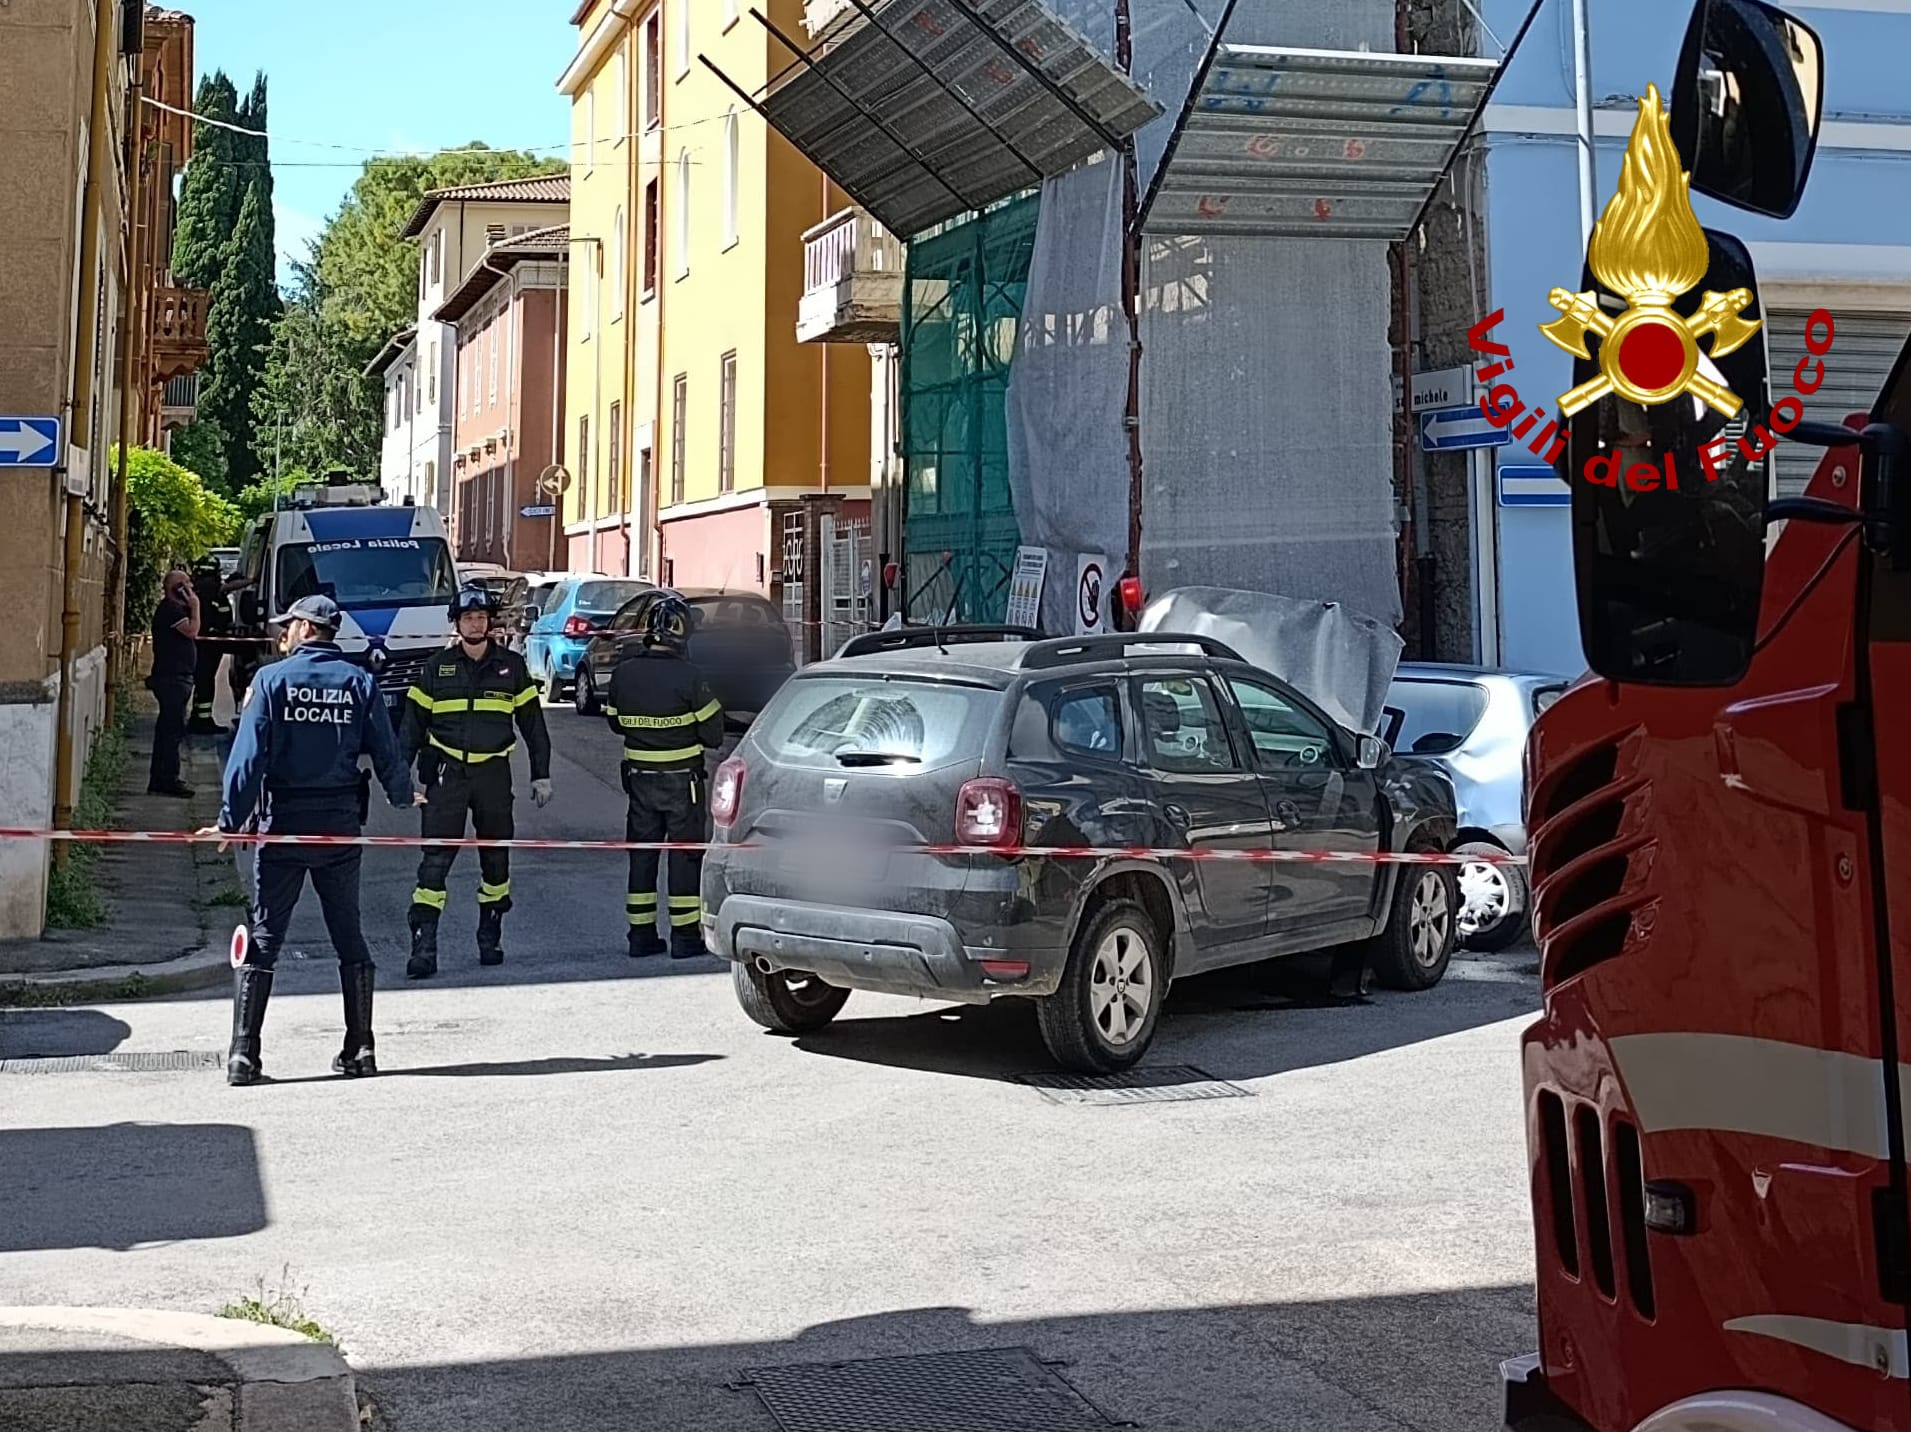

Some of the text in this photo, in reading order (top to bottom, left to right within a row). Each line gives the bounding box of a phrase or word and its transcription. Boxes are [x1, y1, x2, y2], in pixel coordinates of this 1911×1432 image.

[1414, 389, 1448, 405] michele
[287, 687, 354, 705] POLIZIA
[284, 706, 353, 724] LOCALE
[653, 717, 682, 727] FUOCO
